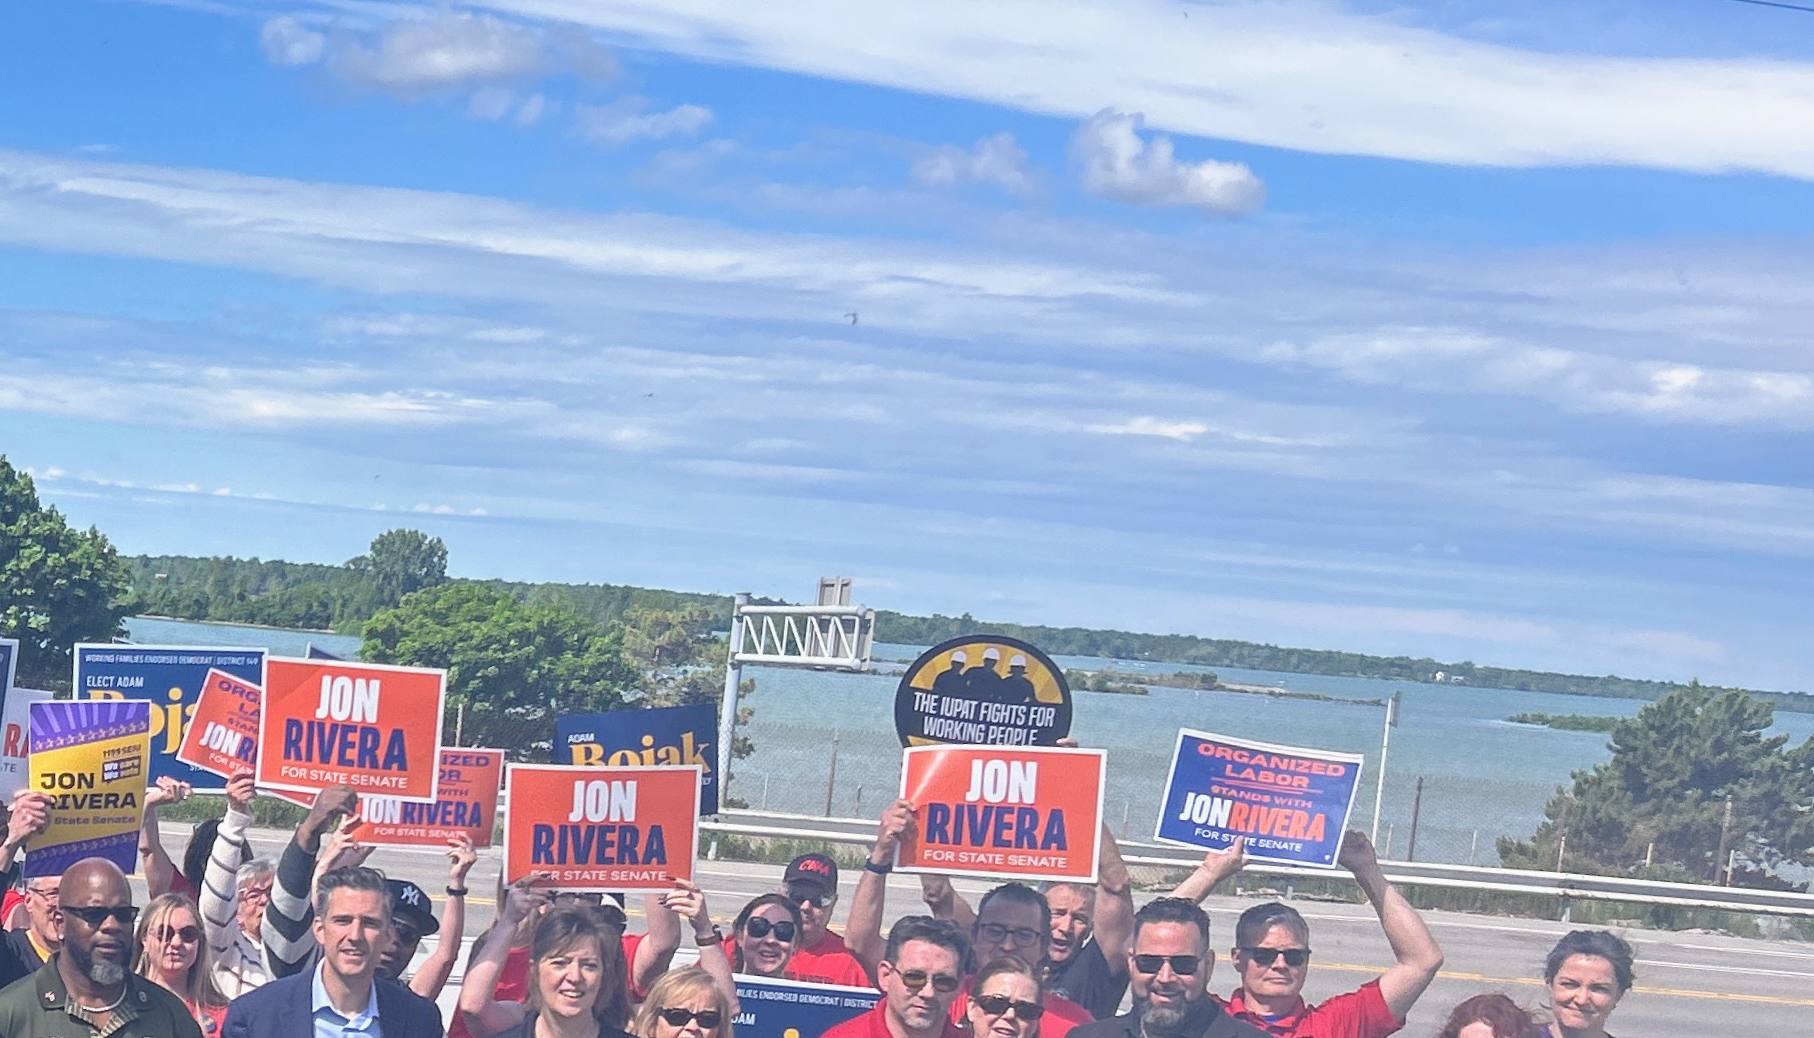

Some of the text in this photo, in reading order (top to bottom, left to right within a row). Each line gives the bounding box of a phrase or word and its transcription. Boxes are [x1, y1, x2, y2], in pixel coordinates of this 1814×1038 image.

[87, 676, 144, 687] ELECT ADAM
[315, 675, 380, 723] JON
[914, 692, 1056, 728] THE IUPAT FIGHTS FOR
[568, 733, 595, 743] ADAM
[923, 717, 1038, 746] WORKING PEOPLE
[283, 719, 408, 772] RIVERA
[209, 753, 228, 765] FOR
[1198, 743, 1345, 777] ORGANIZED
[41, 773, 95, 790] JON
[281, 766, 408, 789] FOR STATE SENATE
[965, 759, 1037, 805] JON
[1226, 765, 1310, 788] LABOR
[568, 780, 637, 823] JON
[1210, 785, 1313, 808] STANDS WITH
[55, 816, 135, 825] State Senate
[374, 827, 427, 837] FOR STATE
[925, 803, 1067, 850] RIVERA
[532, 823, 667, 865] RIVERA
[1194, 828, 1302, 852] FOR SENATE
[923, 850, 1067, 868] FOR STATE SENATE
[564, 870, 667, 881] STATE SENATE
[759, 991, 797, 1002] ENDORSED
[800, 994, 839, 1006] DEMOCRAT
